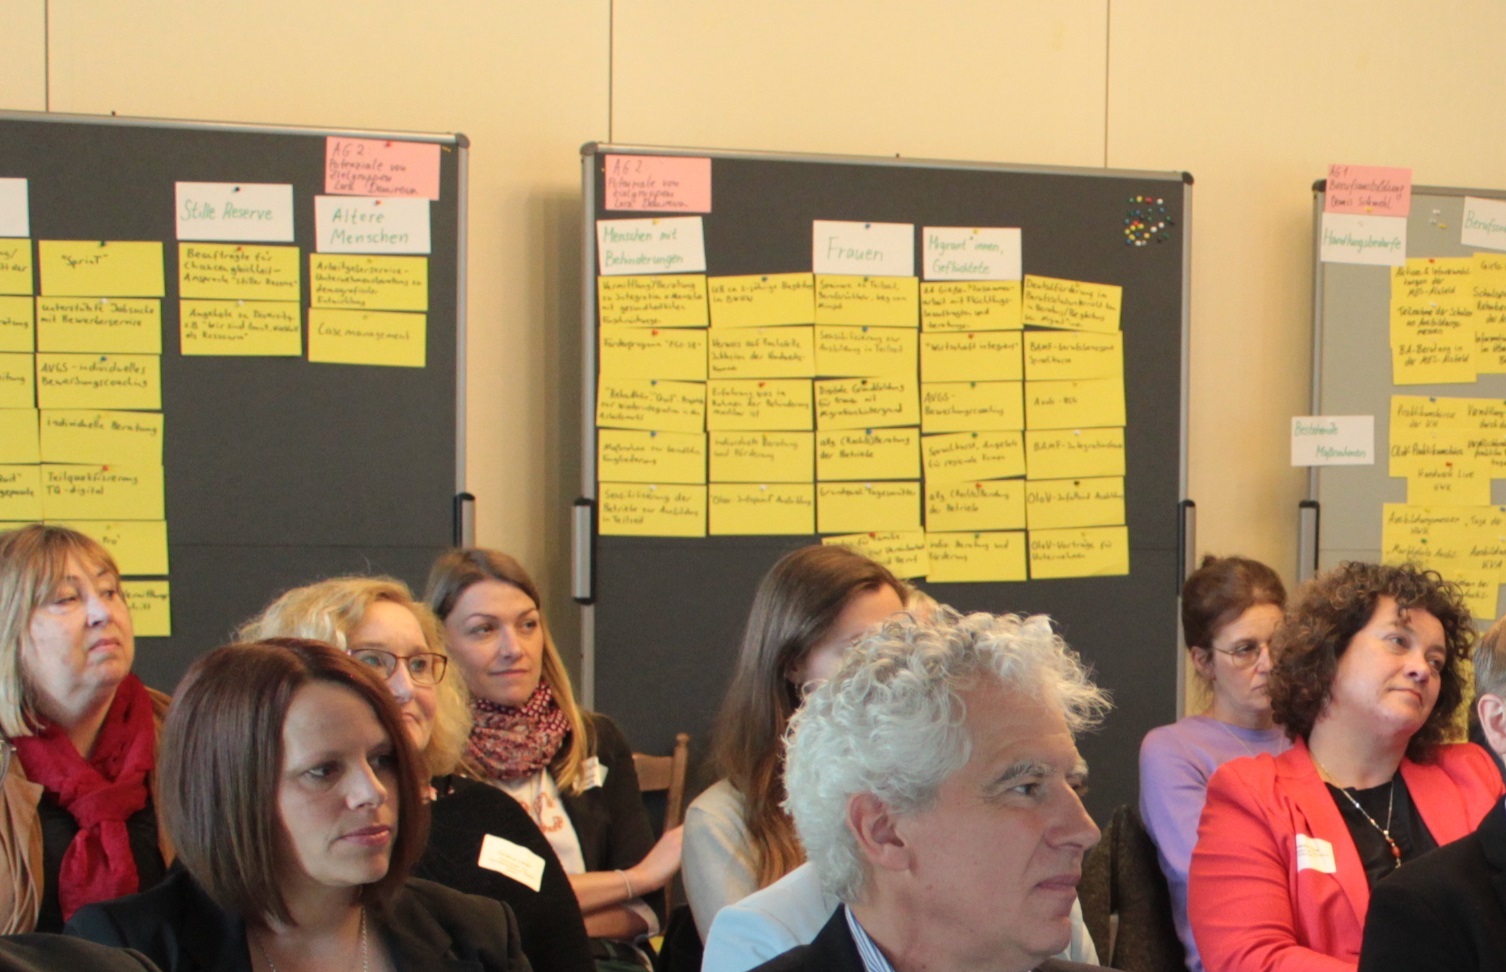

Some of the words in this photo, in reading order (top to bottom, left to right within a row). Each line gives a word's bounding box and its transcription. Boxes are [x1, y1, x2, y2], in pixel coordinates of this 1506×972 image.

[330, 228, 408, 244] Menschen
[603, 226, 651, 243] Menschen
[659, 228, 677, 240] mit
[827, 236, 883, 260] Frauen
[605, 251, 683, 268] Behinderungen
